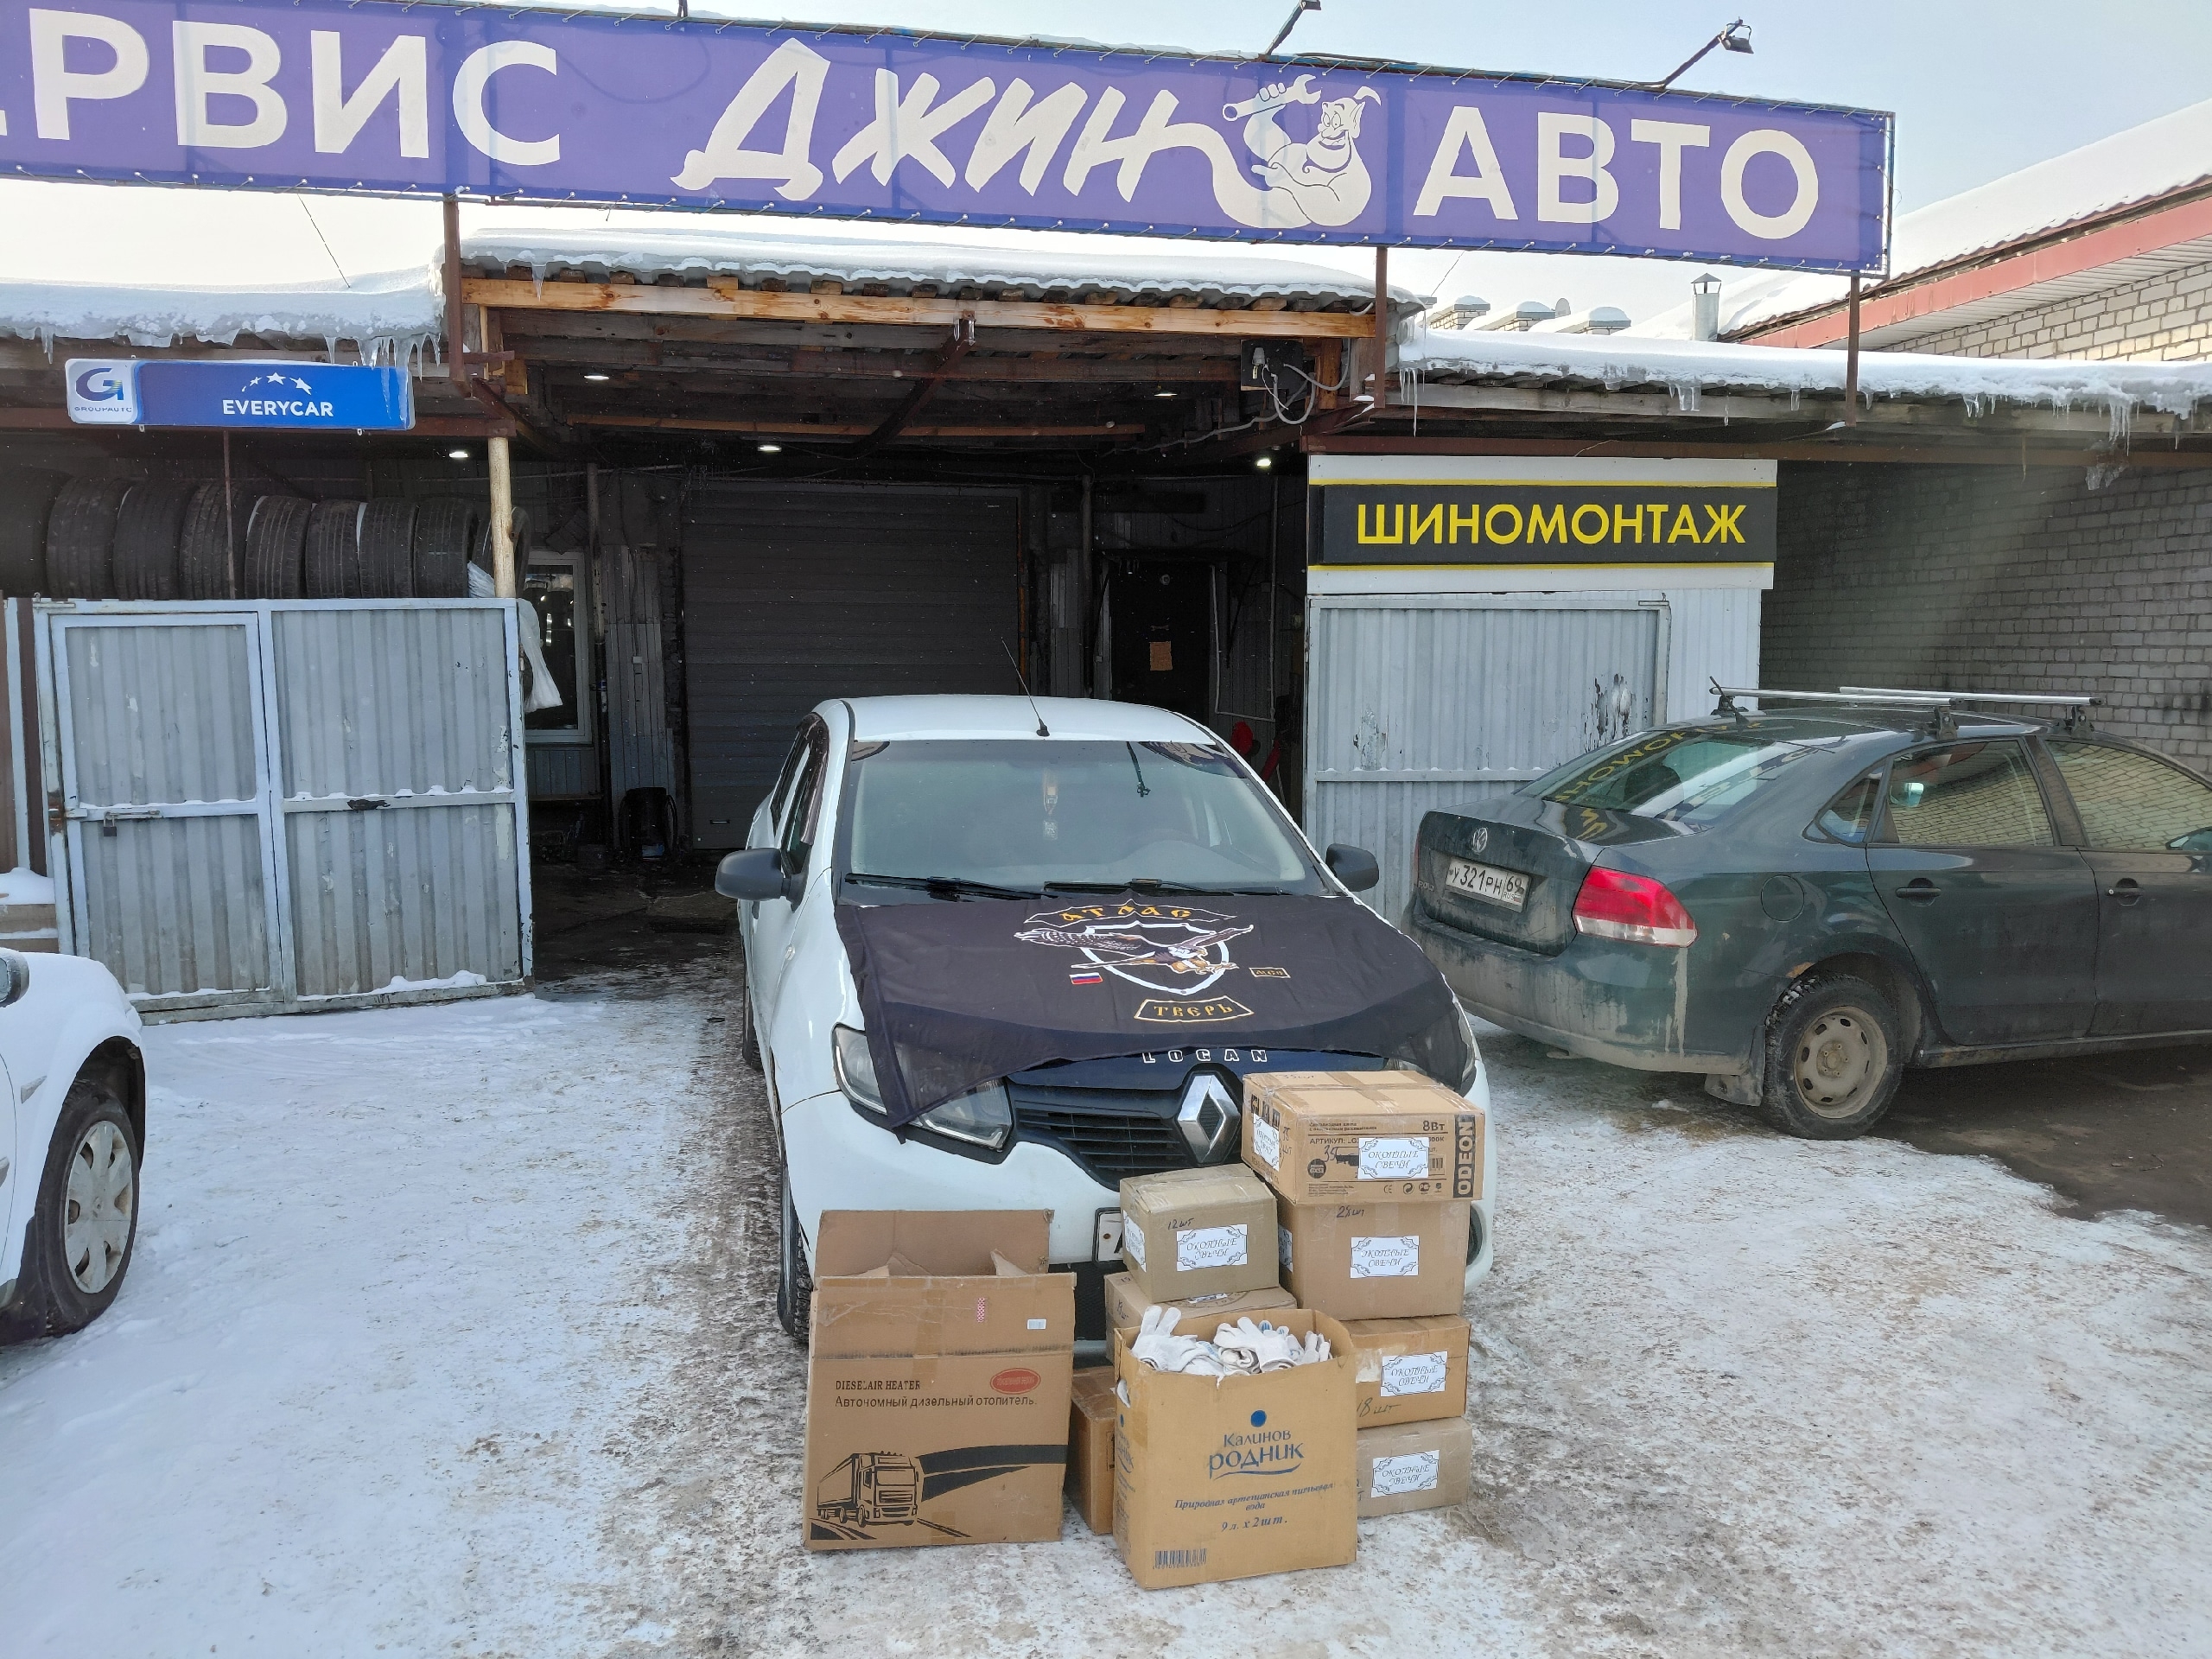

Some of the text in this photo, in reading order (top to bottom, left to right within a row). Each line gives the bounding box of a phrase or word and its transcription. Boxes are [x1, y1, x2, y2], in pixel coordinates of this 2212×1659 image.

[0, 8, 561, 166] РВИС
[1414, 105, 1819, 239] АВТО
[222, 399, 334, 417] EVERYCAR
[1357, 503, 1746, 545] ШИНОМОНТАЖ
[1058, 906, 1192, 922] АТЛАС
[1153, 1003, 1233, 1018] ТВЕРЬ
[1141, 1049, 1268, 1064] LOGAN
[1422, 1120, 1446, 1131] 8Вт
[1376, 1160, 1411, 1169] СВЕЧИ
[1458, 1122, 1473, 1195] ODEON
[1368, 1258, 1403, 1268] СВЕЧИ
[886, 1380, 921, 1390] HEATER
[1398, 1376, 1430, 1387] СВЕЧИ
[835, 1395, 1038, 1409] Автономный дизельный отопитель.
[1174, 1482, 1334, 1510] Природная артезианская питьевая
[1245, 1501, 1266, 1511] вода
